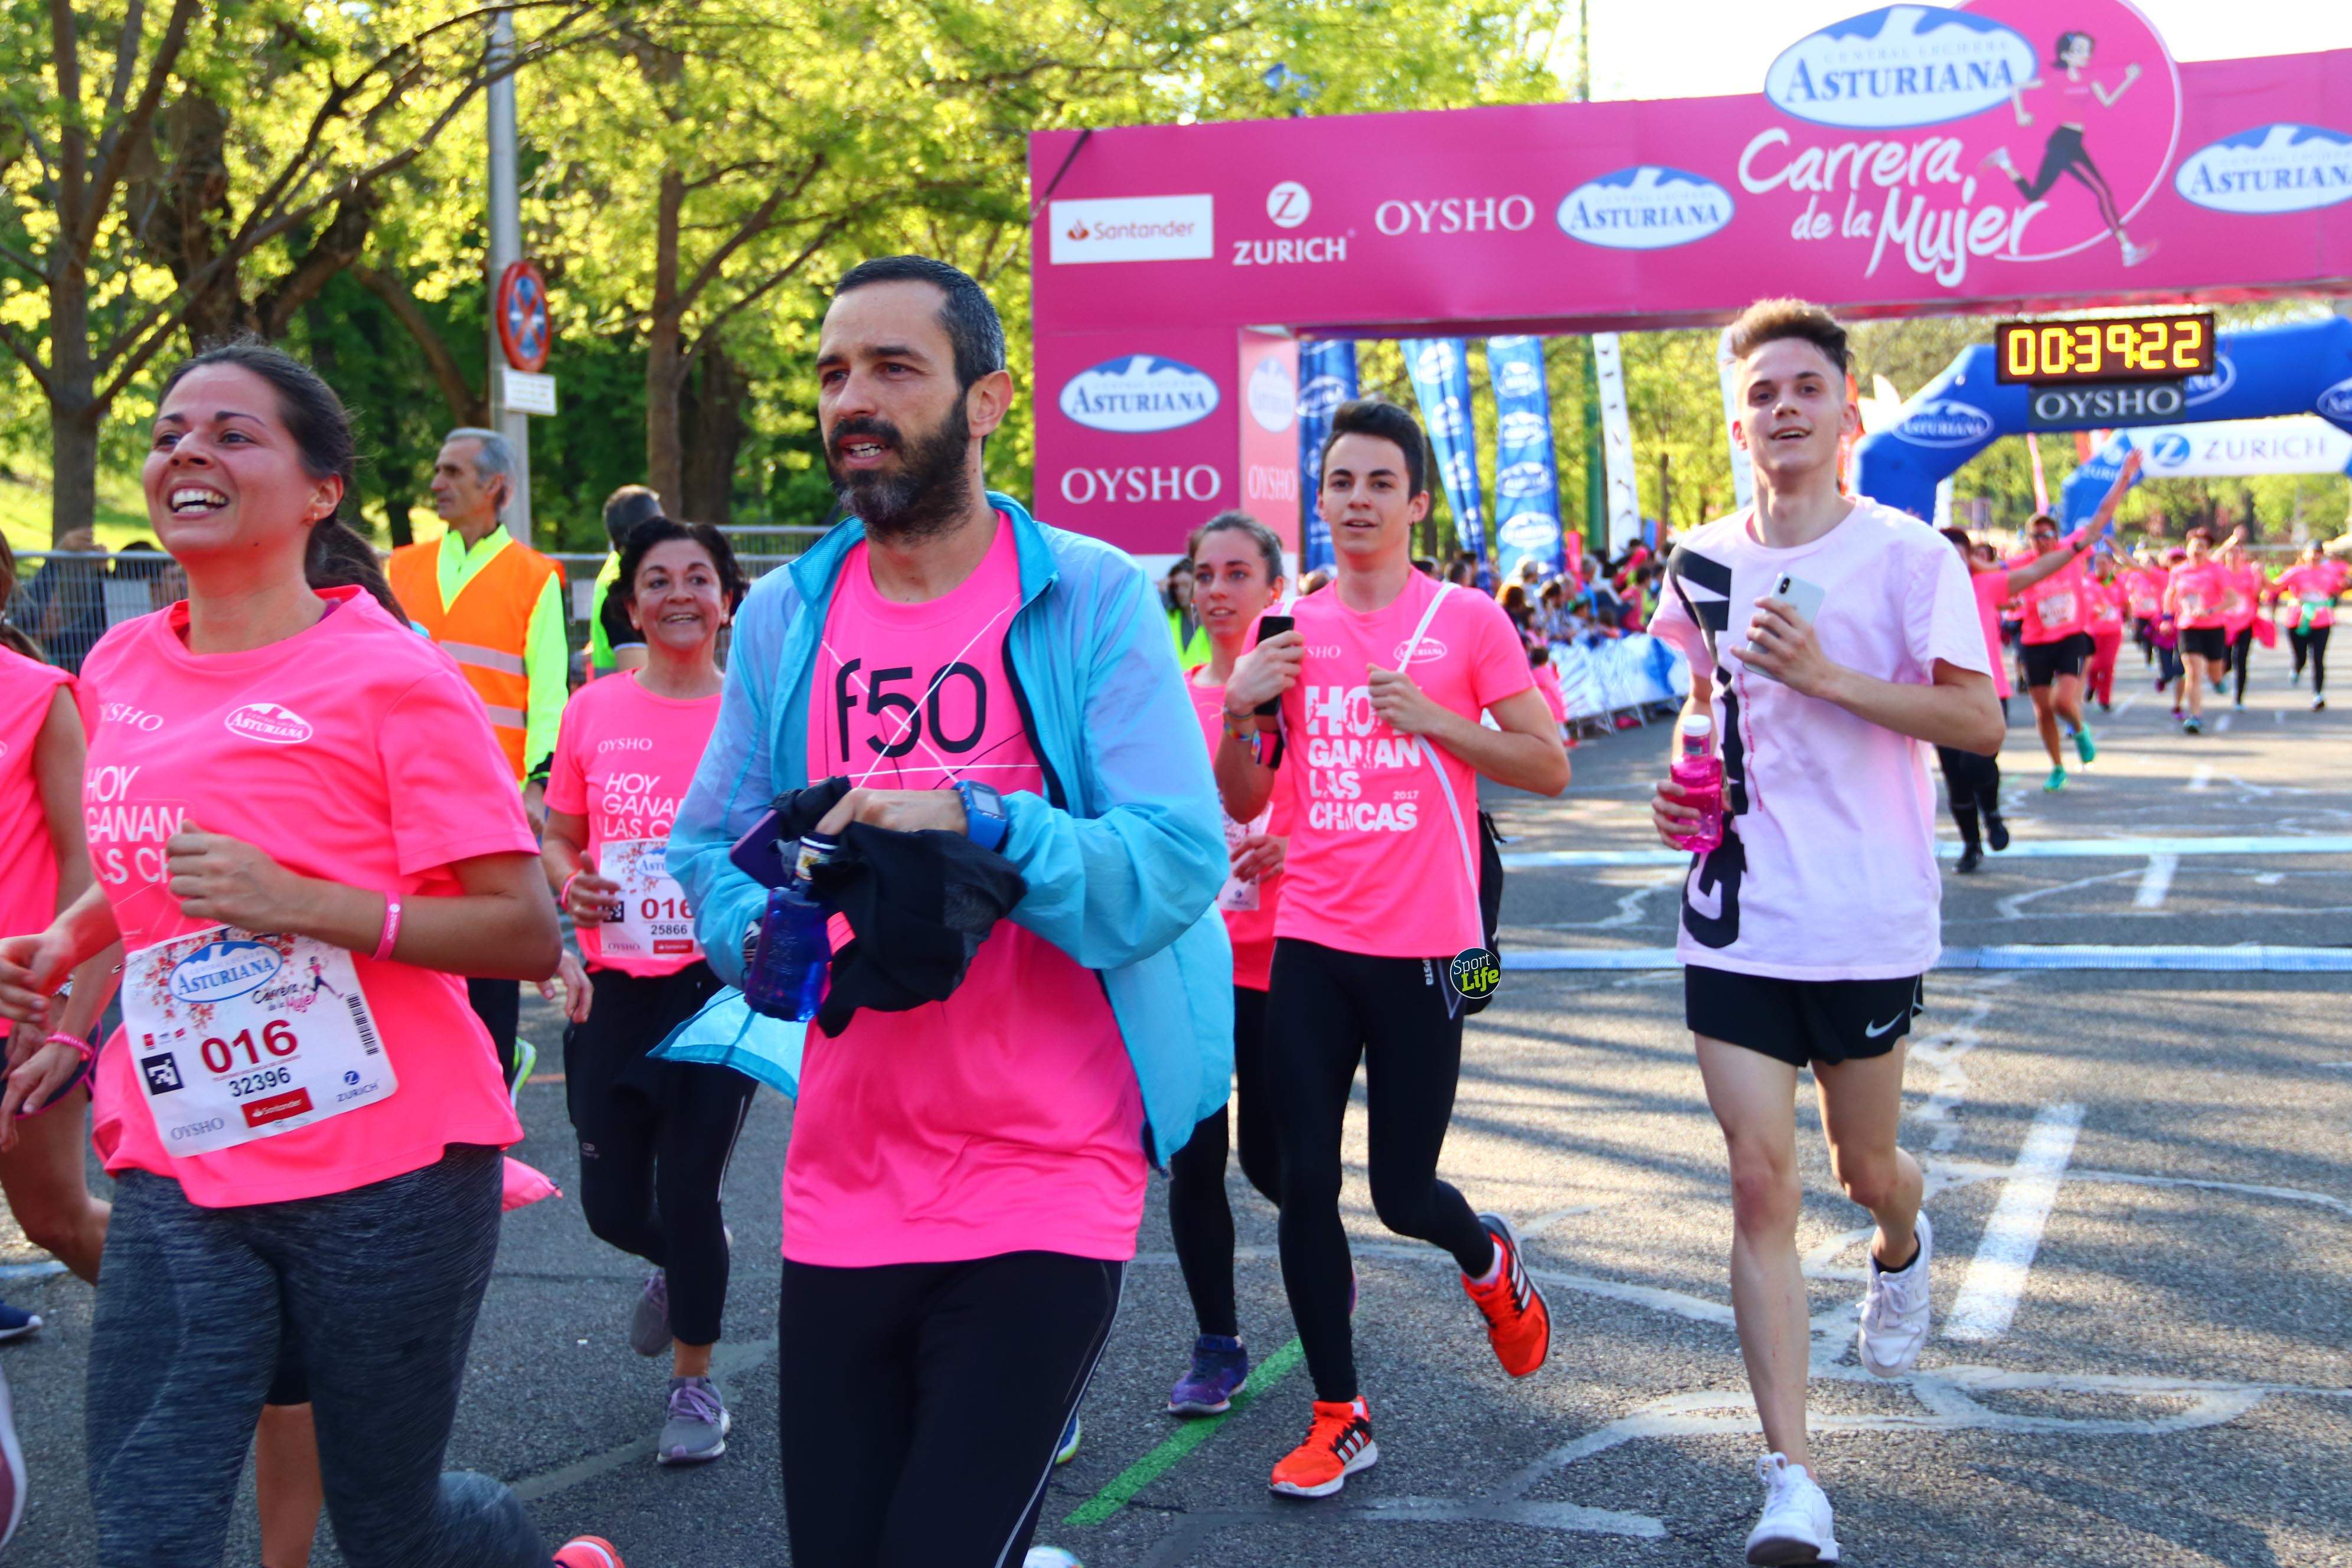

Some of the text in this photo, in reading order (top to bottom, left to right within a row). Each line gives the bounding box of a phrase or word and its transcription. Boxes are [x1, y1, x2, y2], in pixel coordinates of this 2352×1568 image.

[1823, 40, 2009, 63] CENTRAL LECHERA
[1783, 57, 2014, 103] ASTURIANA
[1738, 127, 1964, 194] Carrera
[2191, 162, 2352, 195] ASTURIAN
[1374, 194, 1536, 236] OYSHO
[1571, 199, 1719, 229] ASTURIANA
[1093, 220, 1195, 241] Santander
[1791, 177, 2049, 288] de la Mujer
[1232, 237, 1347, 266] ZURICH
[2008, 320, 2201, 376] 00:39:22
[1072, 386, 1208, 414] ASTURIANA
[2034, 386, 2182, 420] OYSHO
[2203, 436, 2325, 462] ZURICH
[1060, 464, 1221, 504] OYSHO
[1247, 464, 1298, 501] OYSHO
[230, 711, 304, 739] ASTURIANA
[835, 658, 986, 762] f50
[598, 737, 652, 754] OYSHO
[86, 765, 141, 803] HOY
[605, 772, 661, 795] HOY
[1309, 769, 1361, 799] LAS
[1393, 790, 1419, 800] 2017
[603, 816, 642, 839] LAS
[1309, 801, 1418, 832] CHICAS
[651, 924, 688, 936] 25866
[179, 956, 276, 995] ASTURIANA
[201, 1019, 298, 1074] 016
[228, 1067, 291, 1097] 32396
[336, 1082, 380, 1103] ZURICH
[171, 1117, 226, 1141] OYSHO
